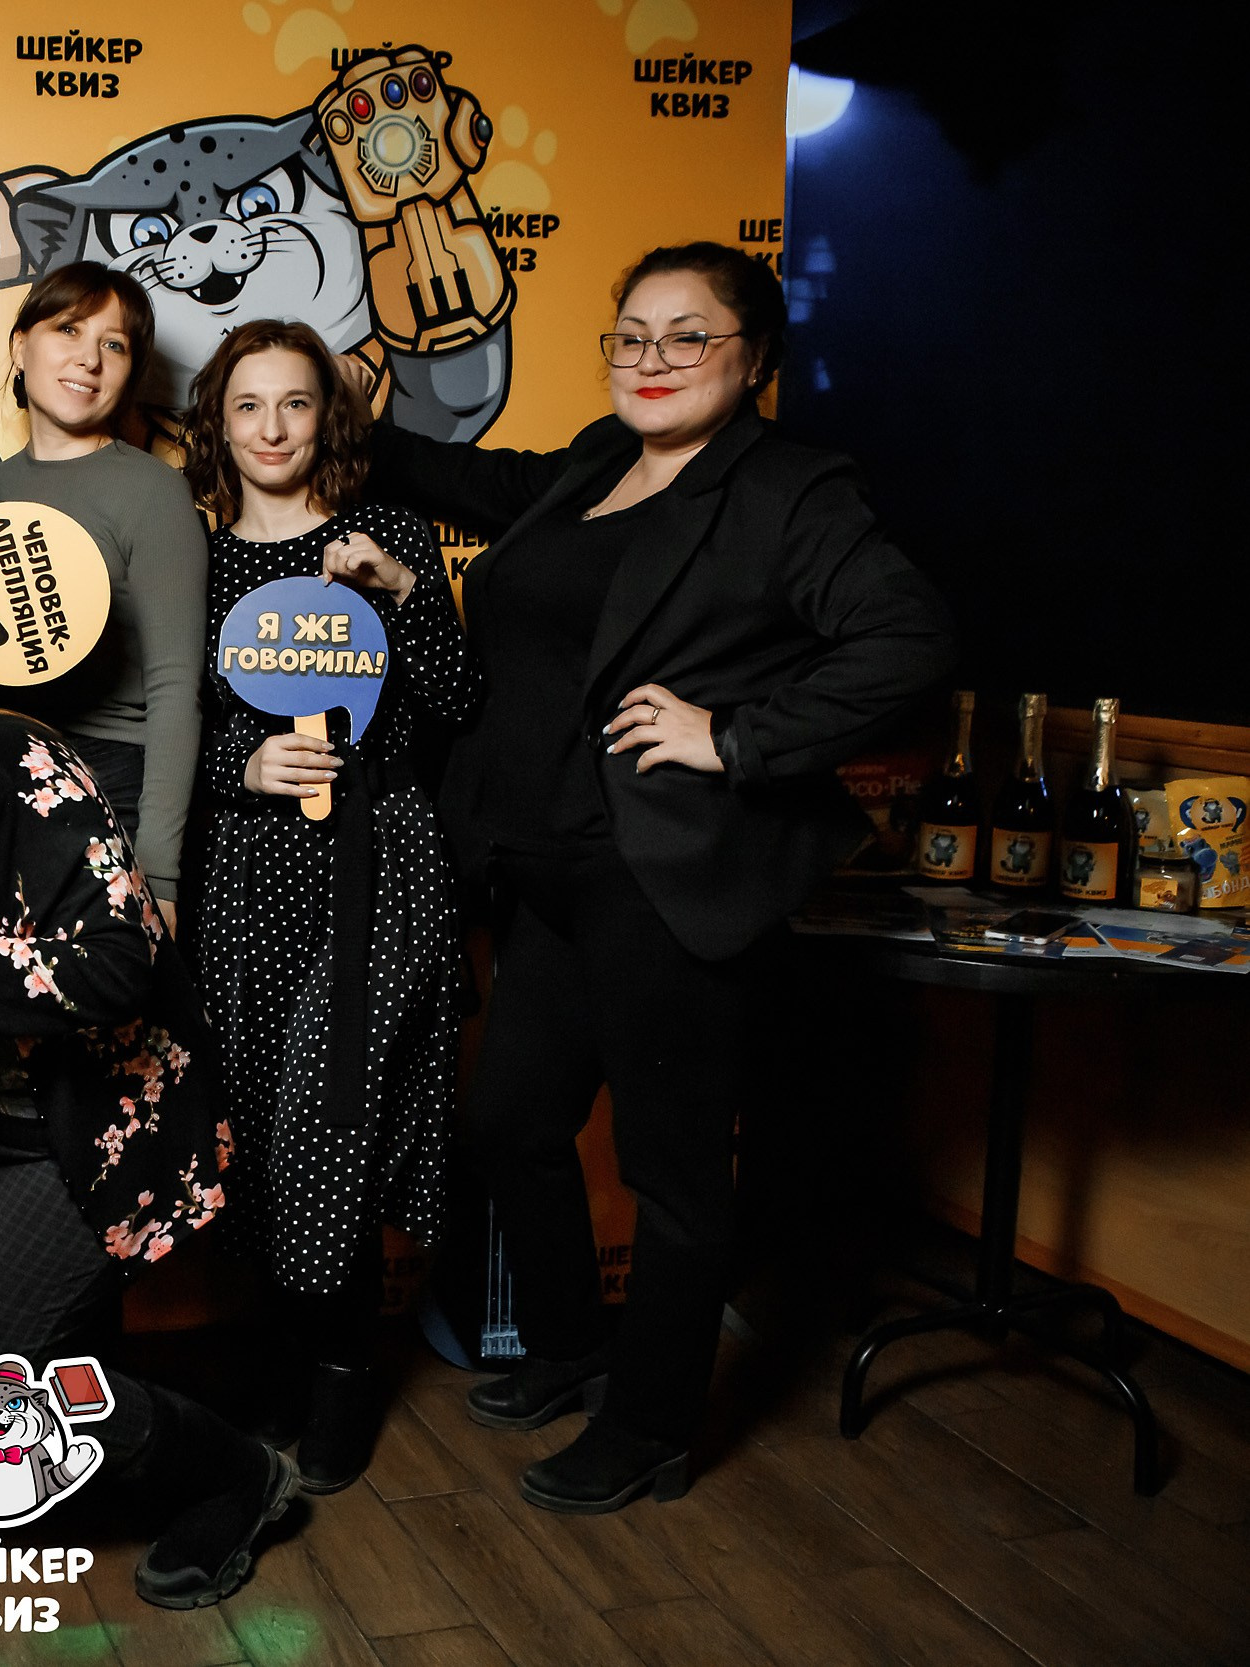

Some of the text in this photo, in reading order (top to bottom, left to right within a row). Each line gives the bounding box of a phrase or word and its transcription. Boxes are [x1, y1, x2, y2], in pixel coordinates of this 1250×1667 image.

[17, 29, 143, 64] ШЕЙКЕР
[36, 71, 120, 98] КВИЗ
[634, 54, 753, 86] ШЕЙКЕР
[651, 92, 730, 119] КВИЗ
[486, 206, 560, 238] ЙКЕР
[499, 247, 537, 272] ИЗ
[22, 520, 70, 652] ЧЕЛОВЕК-
[257, 612, 350, 644] Я ЖЕ
[223, 646, 385, 676] ГОВОРИЛА!
